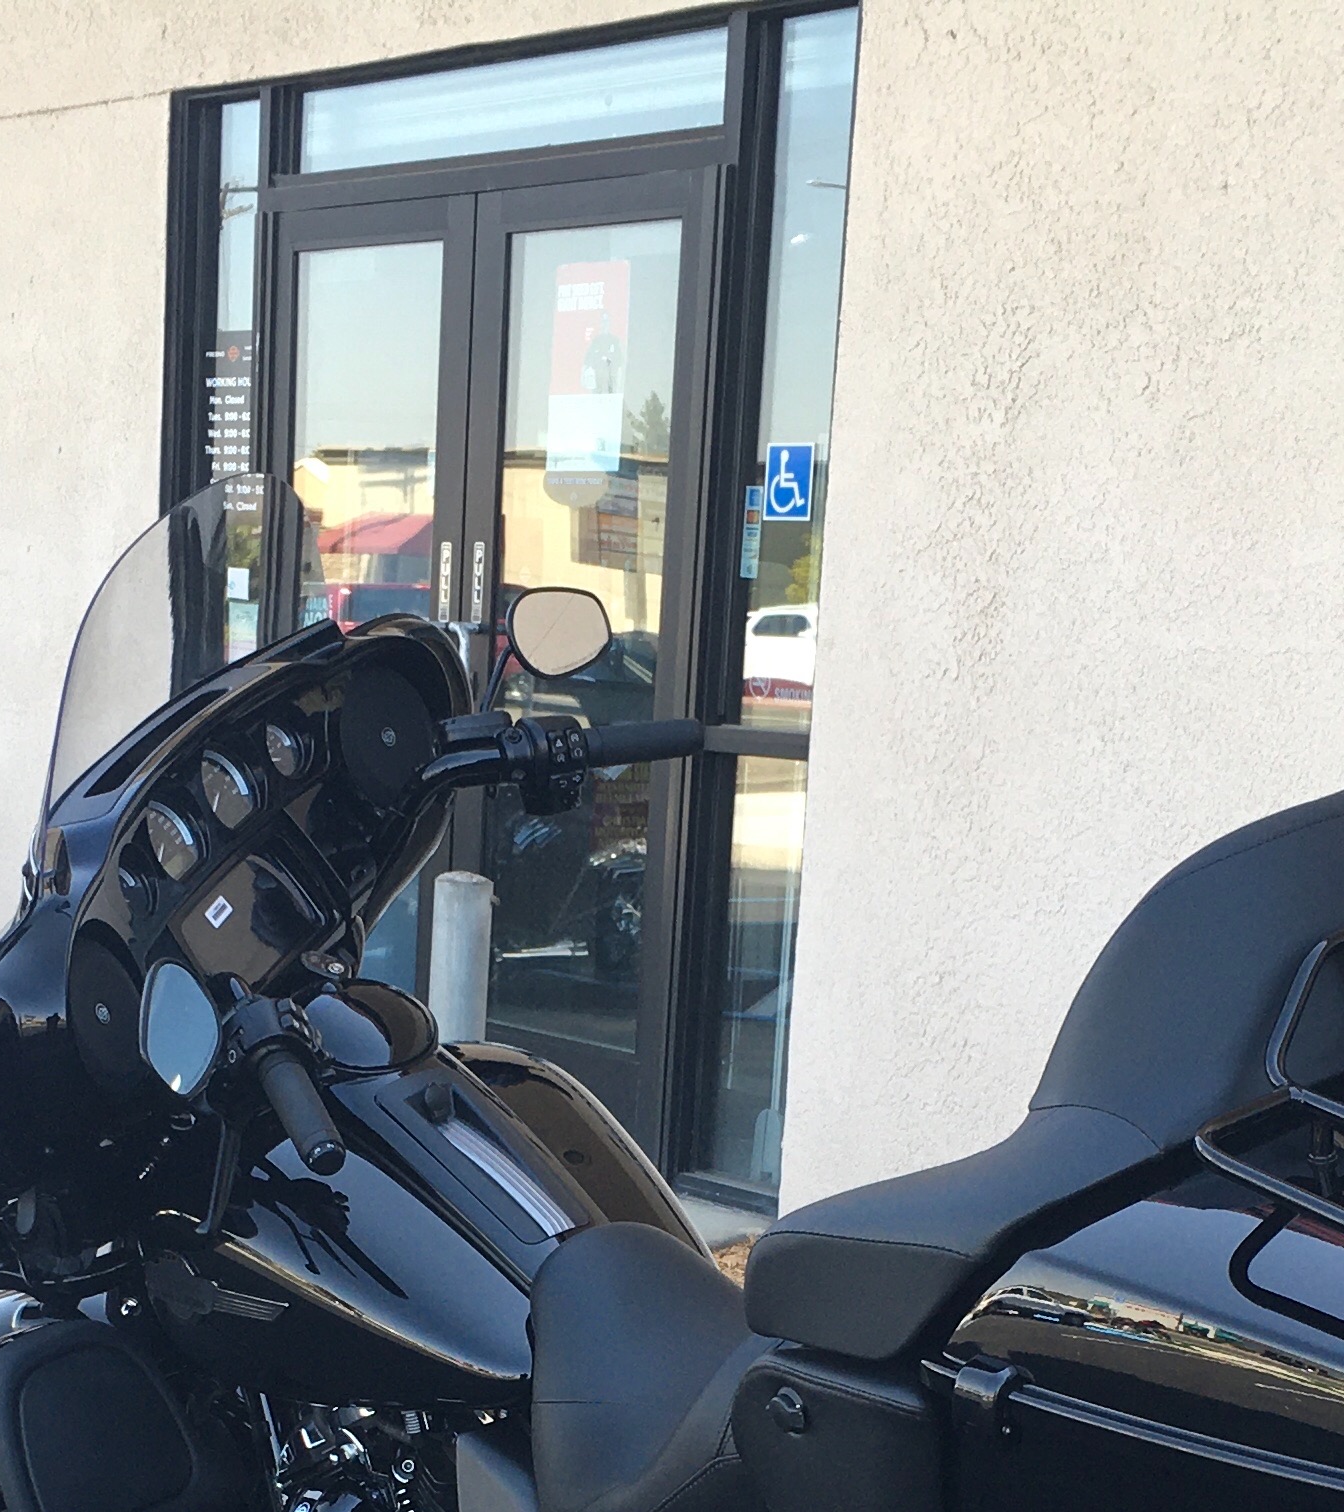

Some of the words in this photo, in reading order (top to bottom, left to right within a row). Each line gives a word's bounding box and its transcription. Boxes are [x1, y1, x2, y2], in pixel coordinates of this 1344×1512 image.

[206, 377, 236, 388] WORKING
[225, 395, 245, 404] Closed
[441, 549, 450, 603] PULL
[474, 549, 483, 603] PULL
